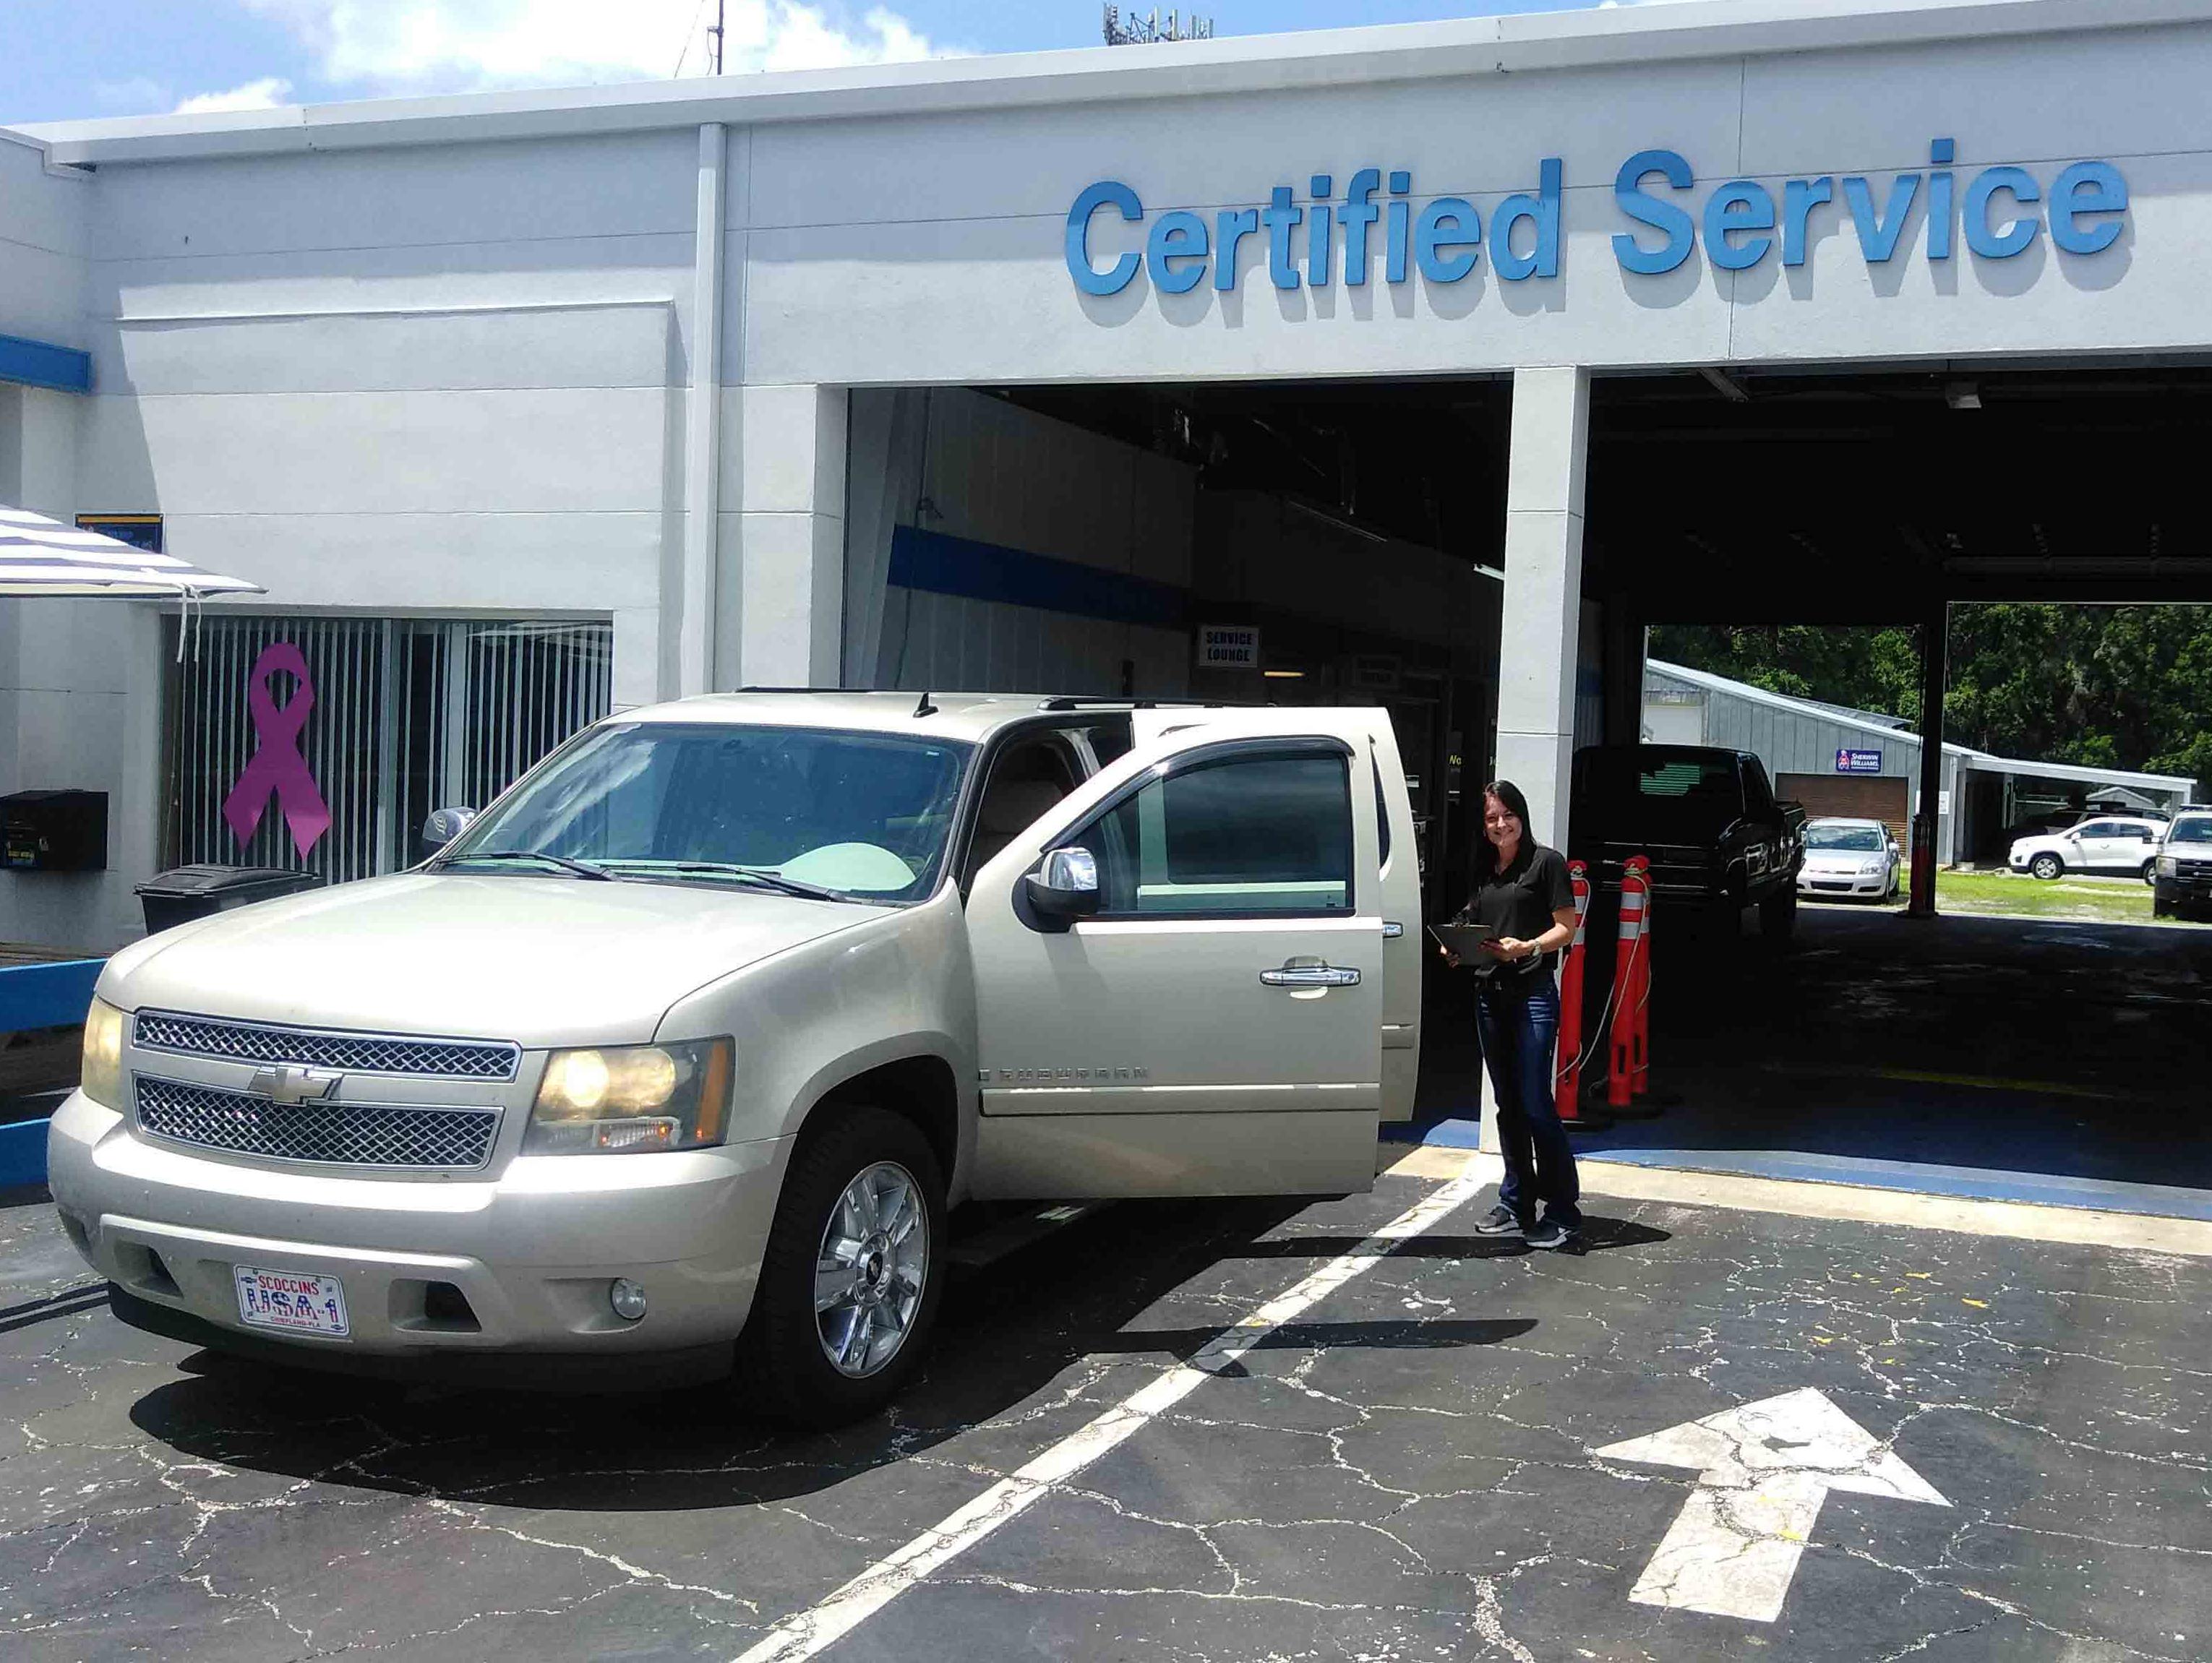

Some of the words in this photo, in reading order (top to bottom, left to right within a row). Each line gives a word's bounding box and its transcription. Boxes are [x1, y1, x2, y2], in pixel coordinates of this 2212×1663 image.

[1066, 158, 1562, 296] Certified
[1612, 138, 2127, 274] Service
[1206, 632, 1252, 645] SERVICE
[1208, 648, 1250, 661] LOUNGE
[999, 1067, 1148, 1080] SUBURBAN
